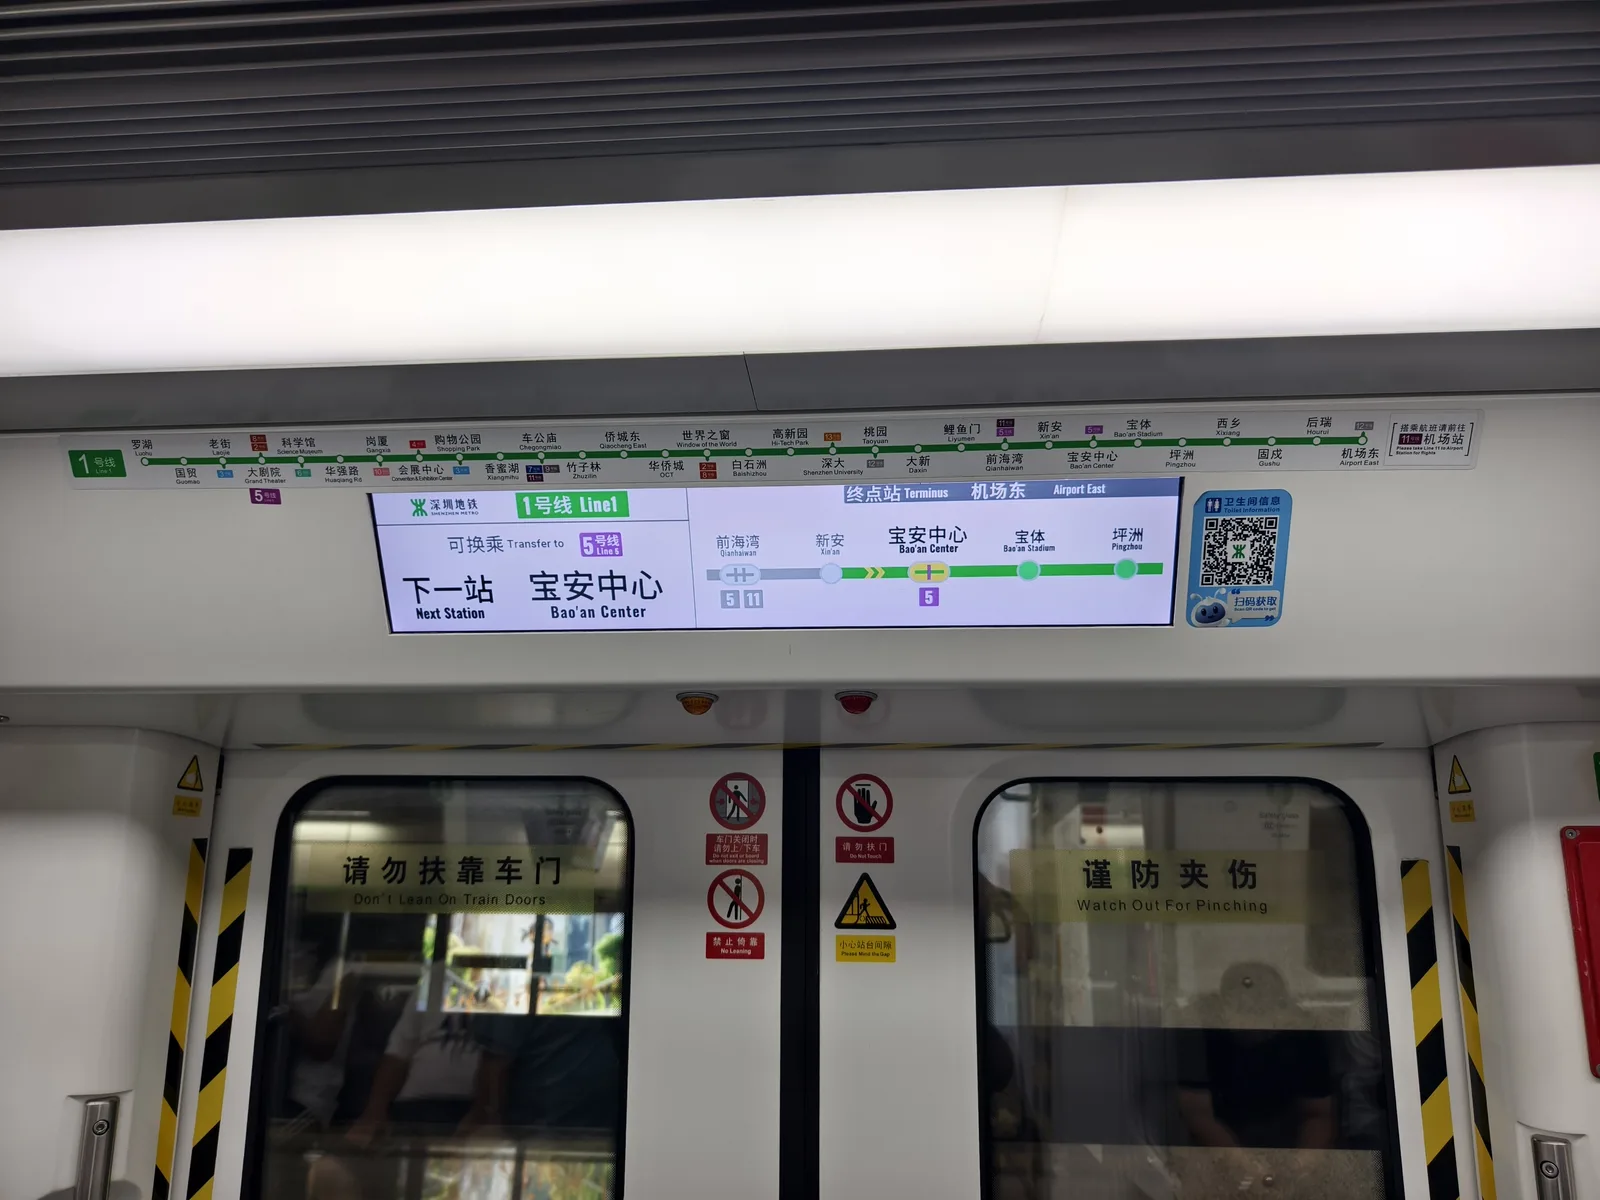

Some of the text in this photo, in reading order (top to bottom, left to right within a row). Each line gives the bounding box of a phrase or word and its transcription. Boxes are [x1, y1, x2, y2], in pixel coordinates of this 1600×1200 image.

[1038, 421, 1062, 432] 新安
[1126, 419, 1152, 430] 宝体
[1217, 418, 1241, 428] 西乡
[1306, 417, 1332, 428] 后瑞
[1400, 424, 1466, 432] 搭乘航班请前往
[682, 430, 730, 440] 世界之窗
[772, 428, 808, 439] 高新园
[864, 426, 887, 436] 桃园
[944, 424, 980, 435] 鲤鱼门
[366, 436, 388, 446] 岗厦
[434, 434, 482, 445] 购物公园
[522, 433, 557, 444] 车公庙
[604, 431, 640, 442] 侨城东
[1424, 434, 1464, 444] 机场站
[131, 440, 153, 450] 罗湖
[209, 439, 231, 450] 老街
[281, 438, 316, 448] 科学馆
[986, 454, 1024, 464] 前海湾
[1067, 451, 1118, 462] 宝安中心
[1170, 450, 1194, 460] 坪洲
[1258, 449, 1282, 460] 固戍
[1341, 448, 1379, 459] 机场东
[79, 454, 116, 474] 1号线
[648, 460, 684, 471] 华侨城
[732, 460, 767, 470] 白石洲
[822, 458, 844, 468] 深大
[906, 456, 930, 466] 大新
[248, 467, 282, 478] 大剧院
[325, 466, 359, 476] 华强路
[398, 465, 444, 475] 会展中心
[485, 464, 520, 474] 香蜜湖
[566, 462, 602, 472] 竹子林
[175, 468, 197, 478] 国贸
[846, 482, 1106, 502] 终点站 Terminus 机场东 Airport East
[430, 498, 478, 510] 深圳地铁
[522, 496, 618, 515] 1号线 Line1
[1224, 496, 1280, 506] 卫生间信息
[888, 526, 968, 545] 宝安中心
[1014, 529, 1046, 544] 宝体
[1112, 527, 1144, 542] 坪洲
[448, 535, 564, 554] 可换乘 Transfer to
[583, 534, 620, 556] 5号线
[716, 534, 760, 550] 前海湾
[816, 534, 844, 548] 新安
[596, 548, 612, 556] Line
[899, 544, 958, 554] Bao'an Center
[1004, 544, 1056, 552] Bao'an Stadium
[1112, 543, 1142, 551] Pingzhou
[720, 550, 757, 558] Qianhaiwan
[402, 570, 664, 604] 下一站 宝安中心
[726, 592, 760, 606] 5 11
[924, 590, 934, 604] 5
[1234, 596, 1278, 606] 扫码获取
[416, 606, 485, 620] Next Station
[550, 606, 646, 618] Bao'an Center
[716, 834, 758, 844] 车门关闭时
[714, 844, 760, 852] 请勿上/下车
[842, 842, 888, 852] 请勿扶门
[343, 855, 562, 886] 请勿扶靠车门
[1082, 858, 1258, 890] 谨防夹伤
[400, 892, 432, 906] Lean
[439, 892, 456, 906] On
[463, 892, 498, 906] Train
[506, 892, 546, 906] Doors
[1078, 899, 1268, 914] Watch Out For Pinching
[713, 936, 758, 946] 禁止倚靠
[840, 940, 892, 950] 小心站台间隙
